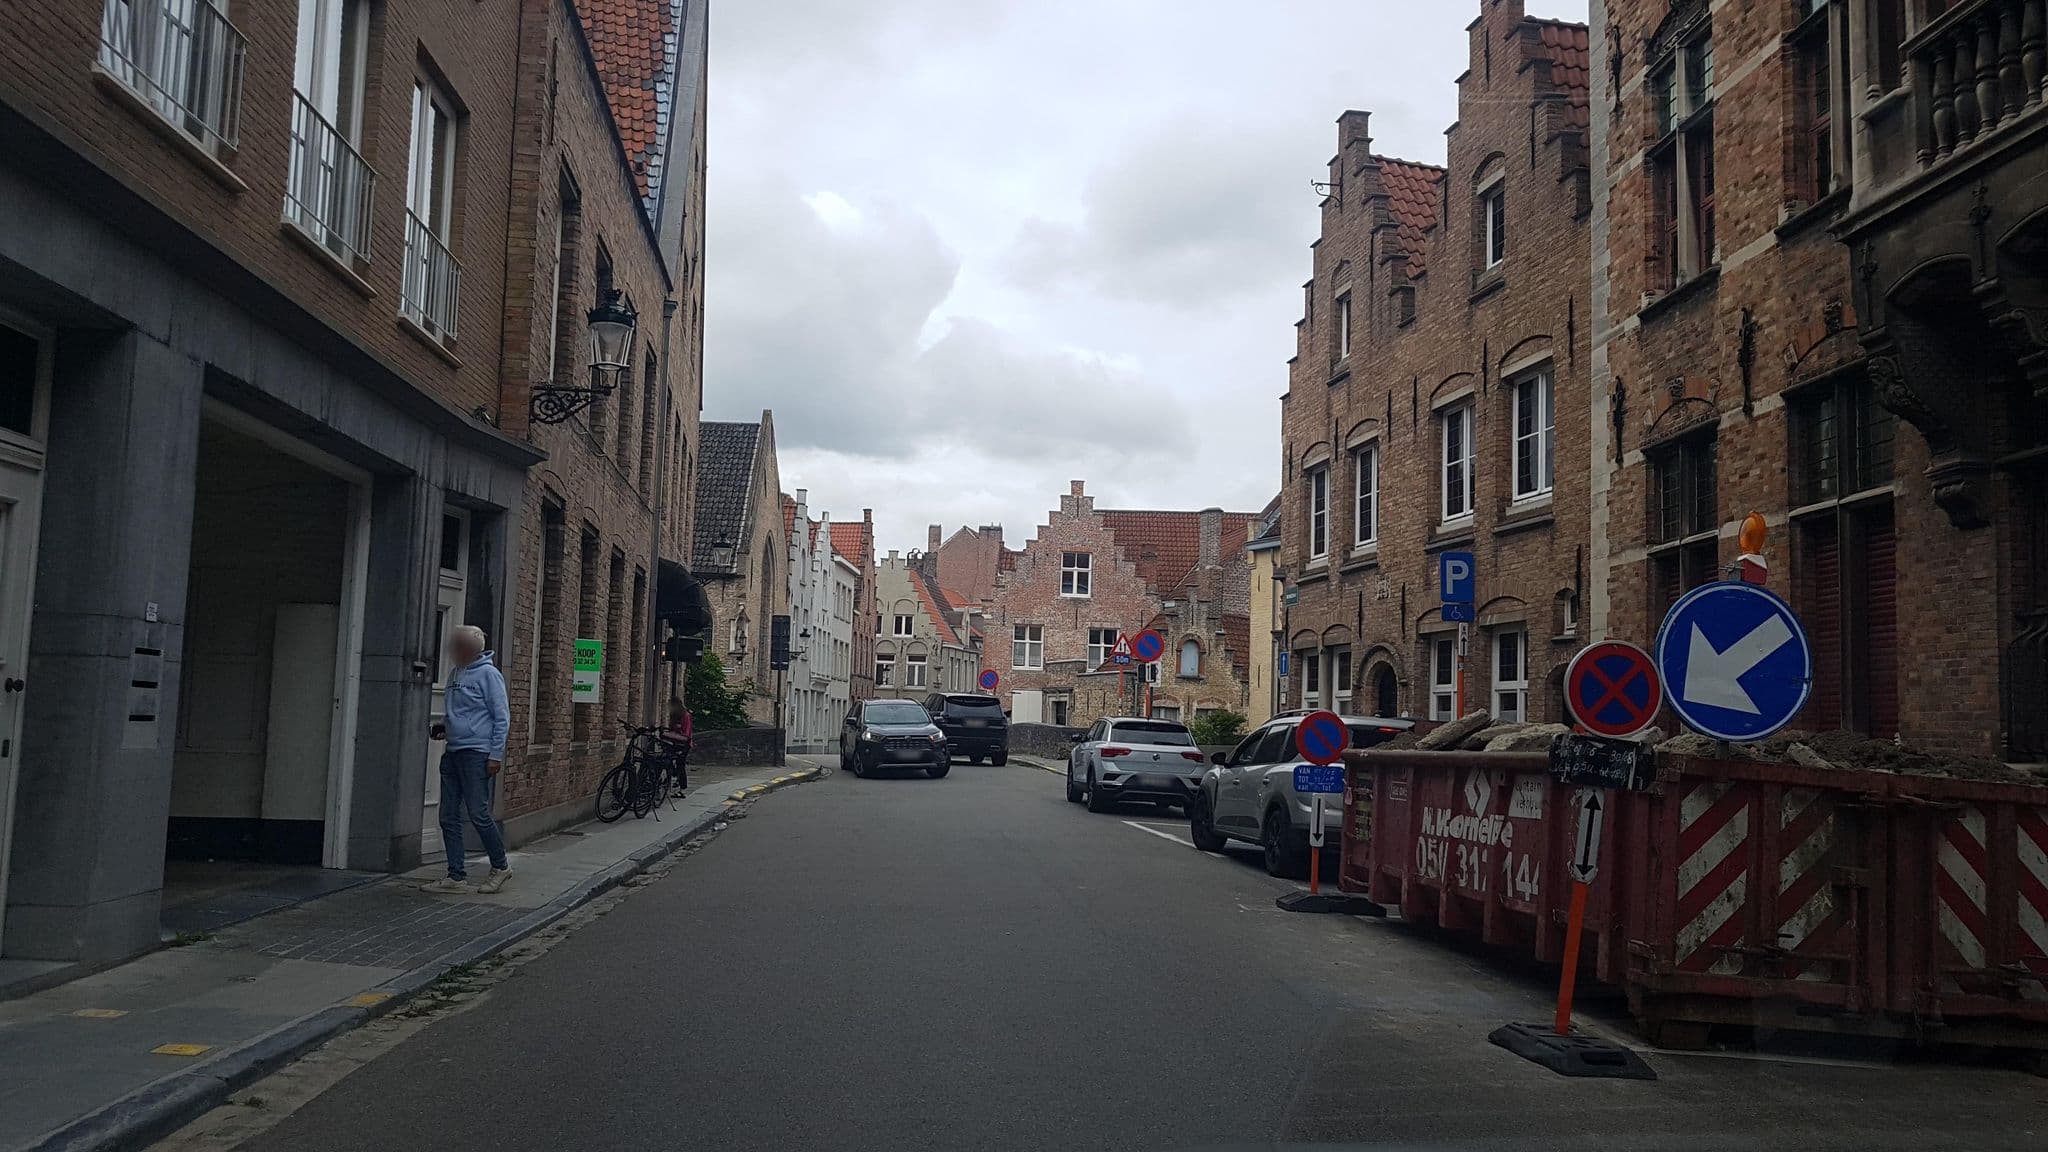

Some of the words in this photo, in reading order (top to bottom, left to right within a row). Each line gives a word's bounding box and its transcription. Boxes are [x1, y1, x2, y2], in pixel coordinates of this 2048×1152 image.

[1446, 560, 1469, 594] P
[577, 648, 596, 658] KOOP
[1298, 775, 1309, 783] TOT
